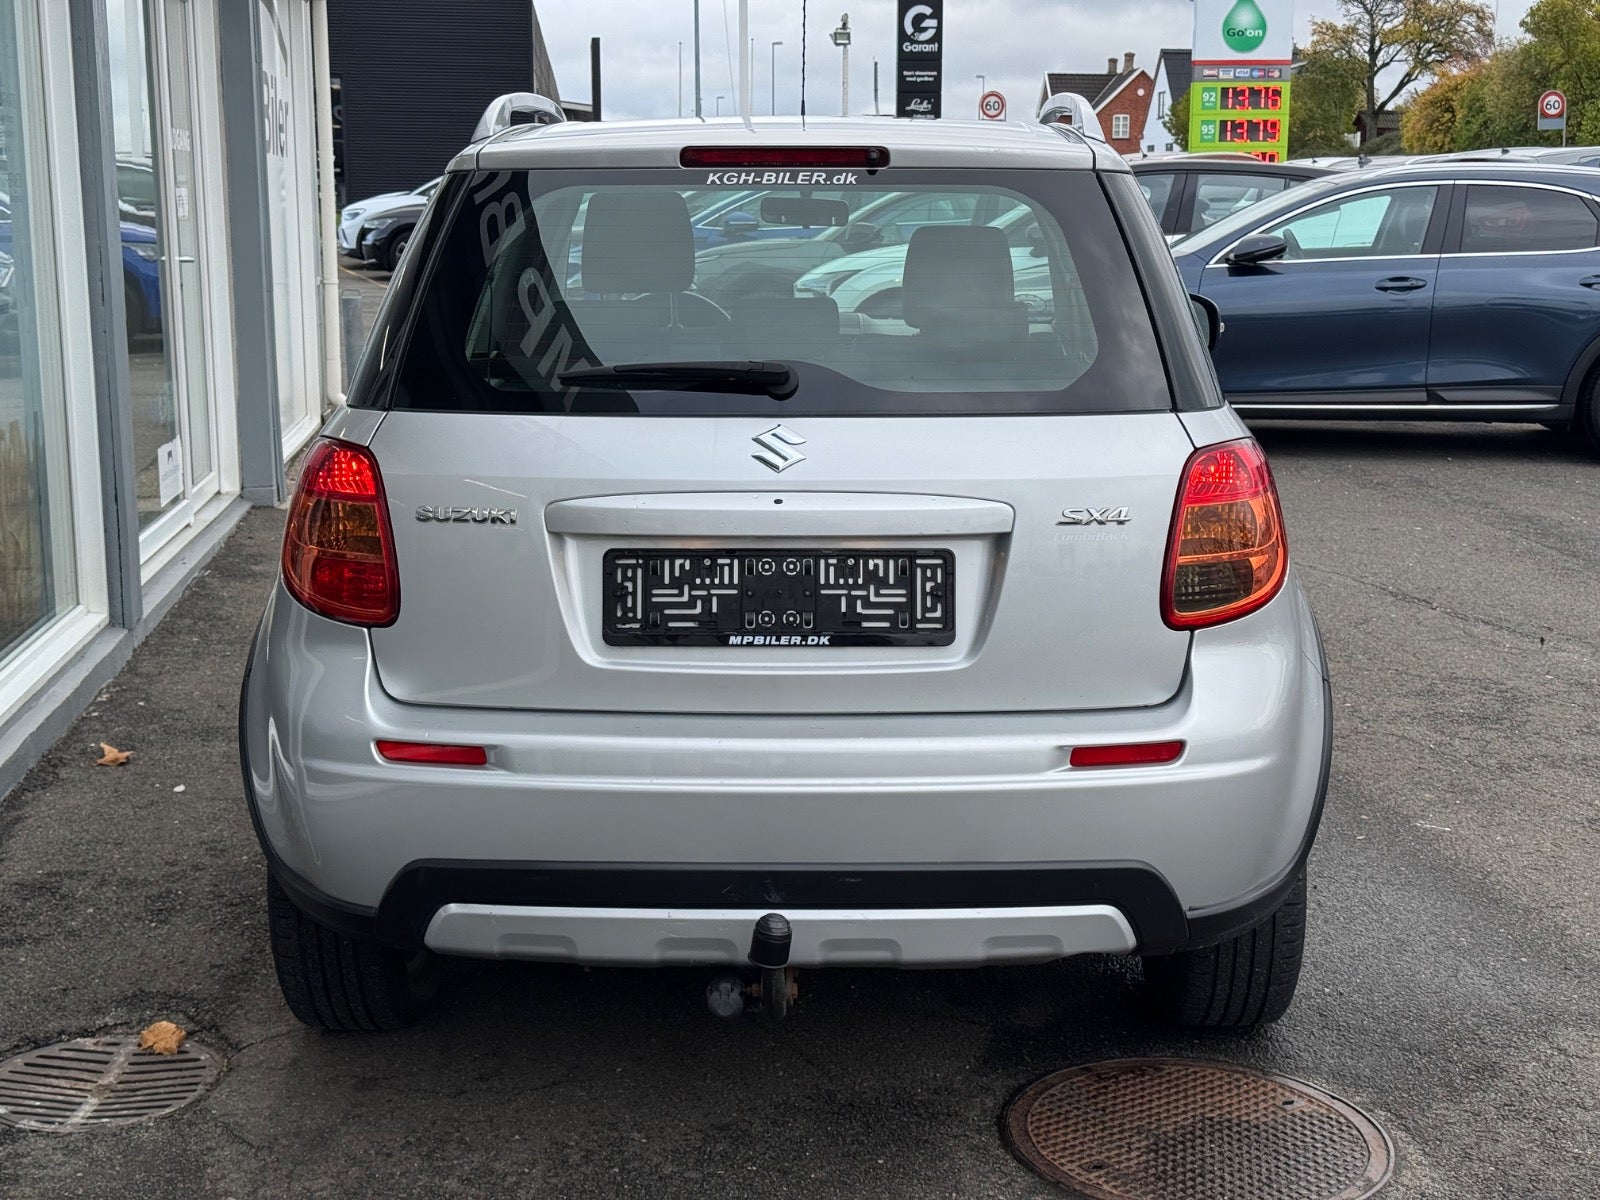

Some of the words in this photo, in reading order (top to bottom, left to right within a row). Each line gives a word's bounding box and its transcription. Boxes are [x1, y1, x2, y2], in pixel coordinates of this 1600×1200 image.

[902, 42, 939, 52] Garant
[985, 100, 1000, 111] 60
[1203, 92, 1216, 102] 92
[1228, 85, 1282, 111] 13.76
[1545, 100, 1560, 110] 60
[263, 71, 288, 158] Biler
[1201, 125, 1215, 134] 95
[1226, 118, 1280, 143] 13.79
[706, 172, 859, 185] KGH-BILER.dk
[415, 505, 518, 524] SUZUKI
[1055, 506, 1132, 526] SX4
[728, 635, 831, 645] MPBILER.DK
